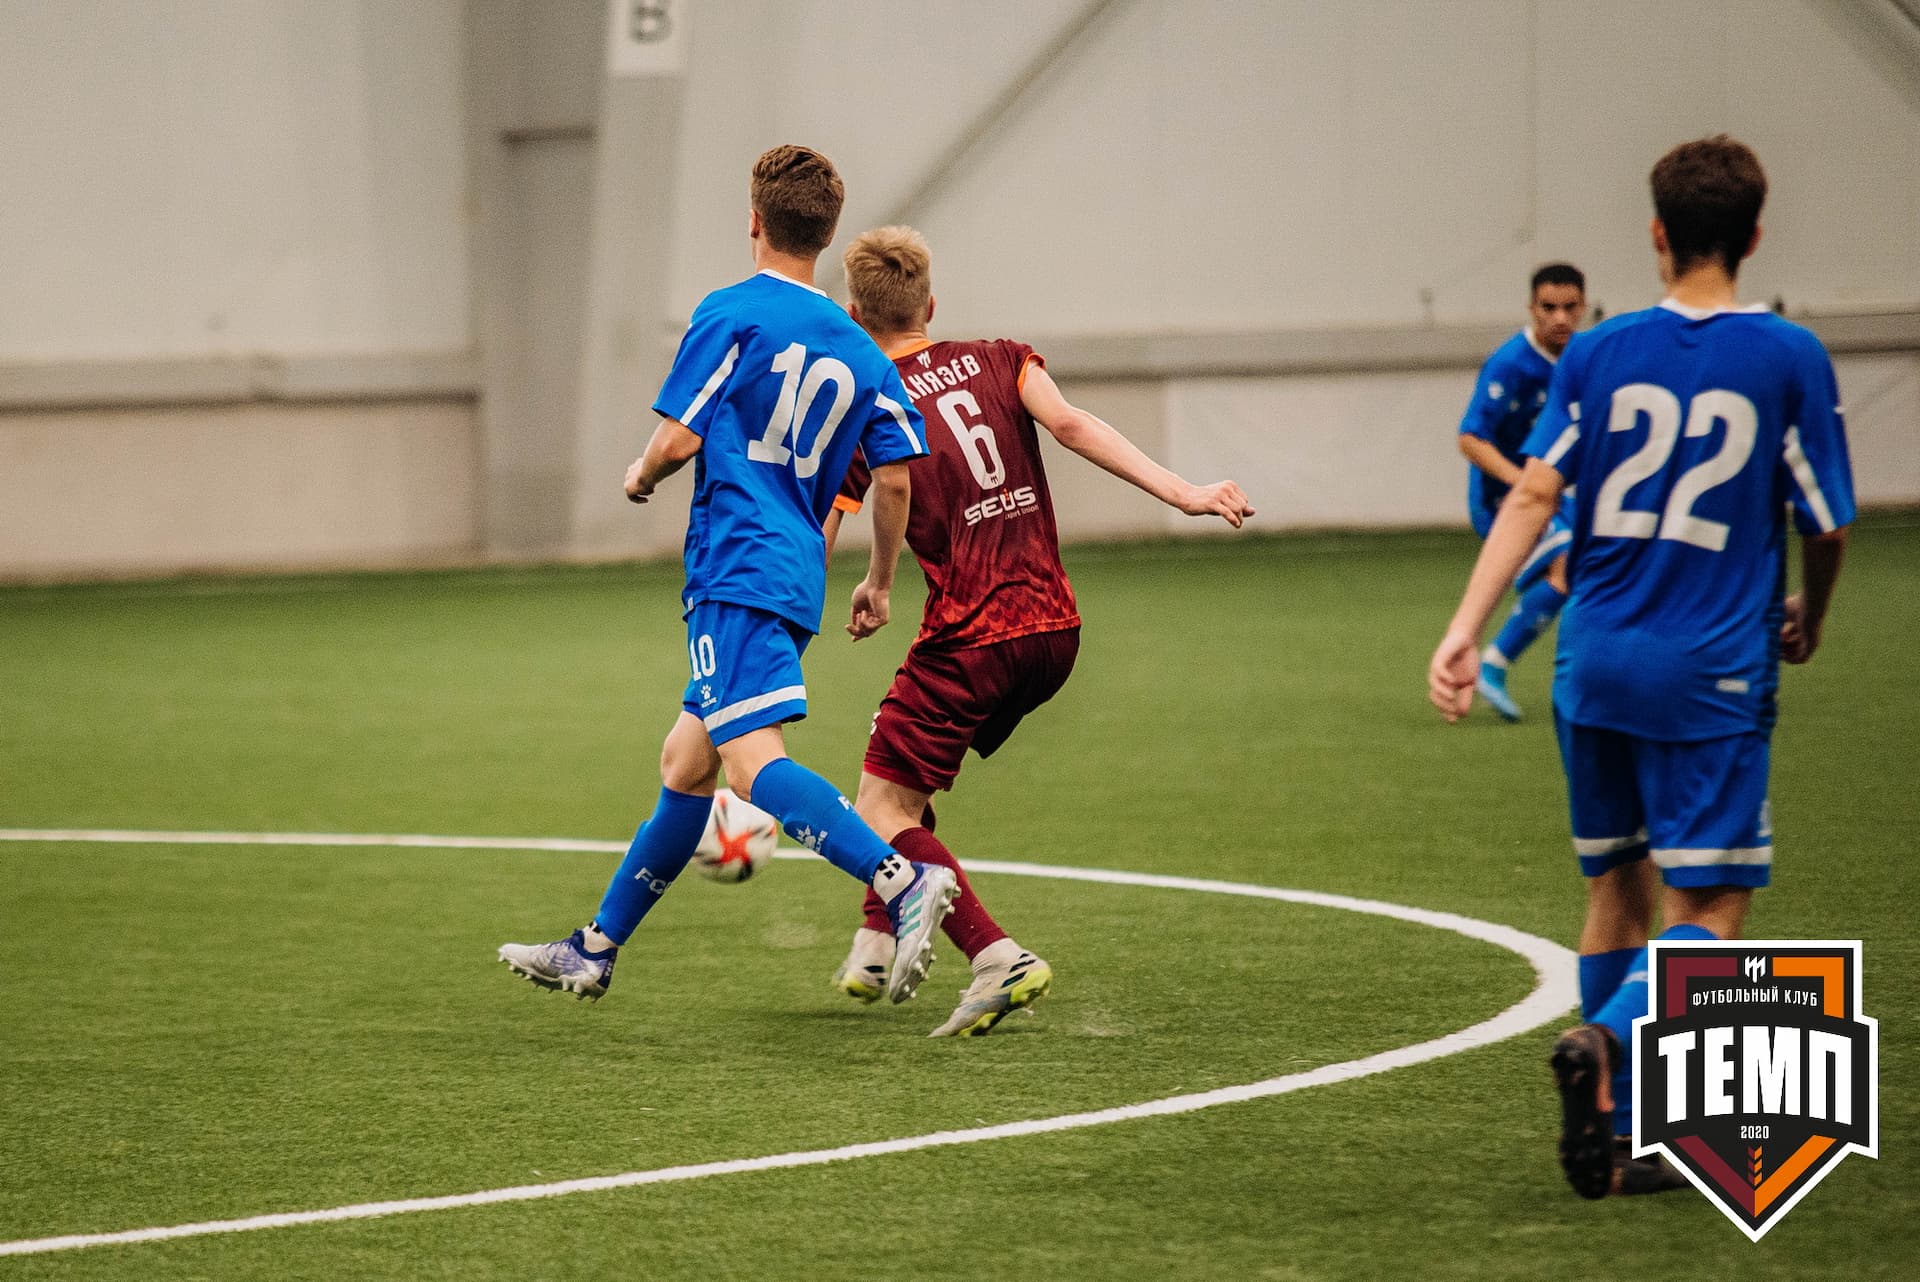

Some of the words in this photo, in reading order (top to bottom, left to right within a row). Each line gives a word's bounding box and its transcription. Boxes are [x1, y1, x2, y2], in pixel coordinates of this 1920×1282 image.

[747, 341, 856, 478] 10
[936, 389, 1006, 490] 6
[964, 485, 1037, 526] SEUS
[1592, 383, 1758, 552] 22
[689, 633, 716, 682] 10
